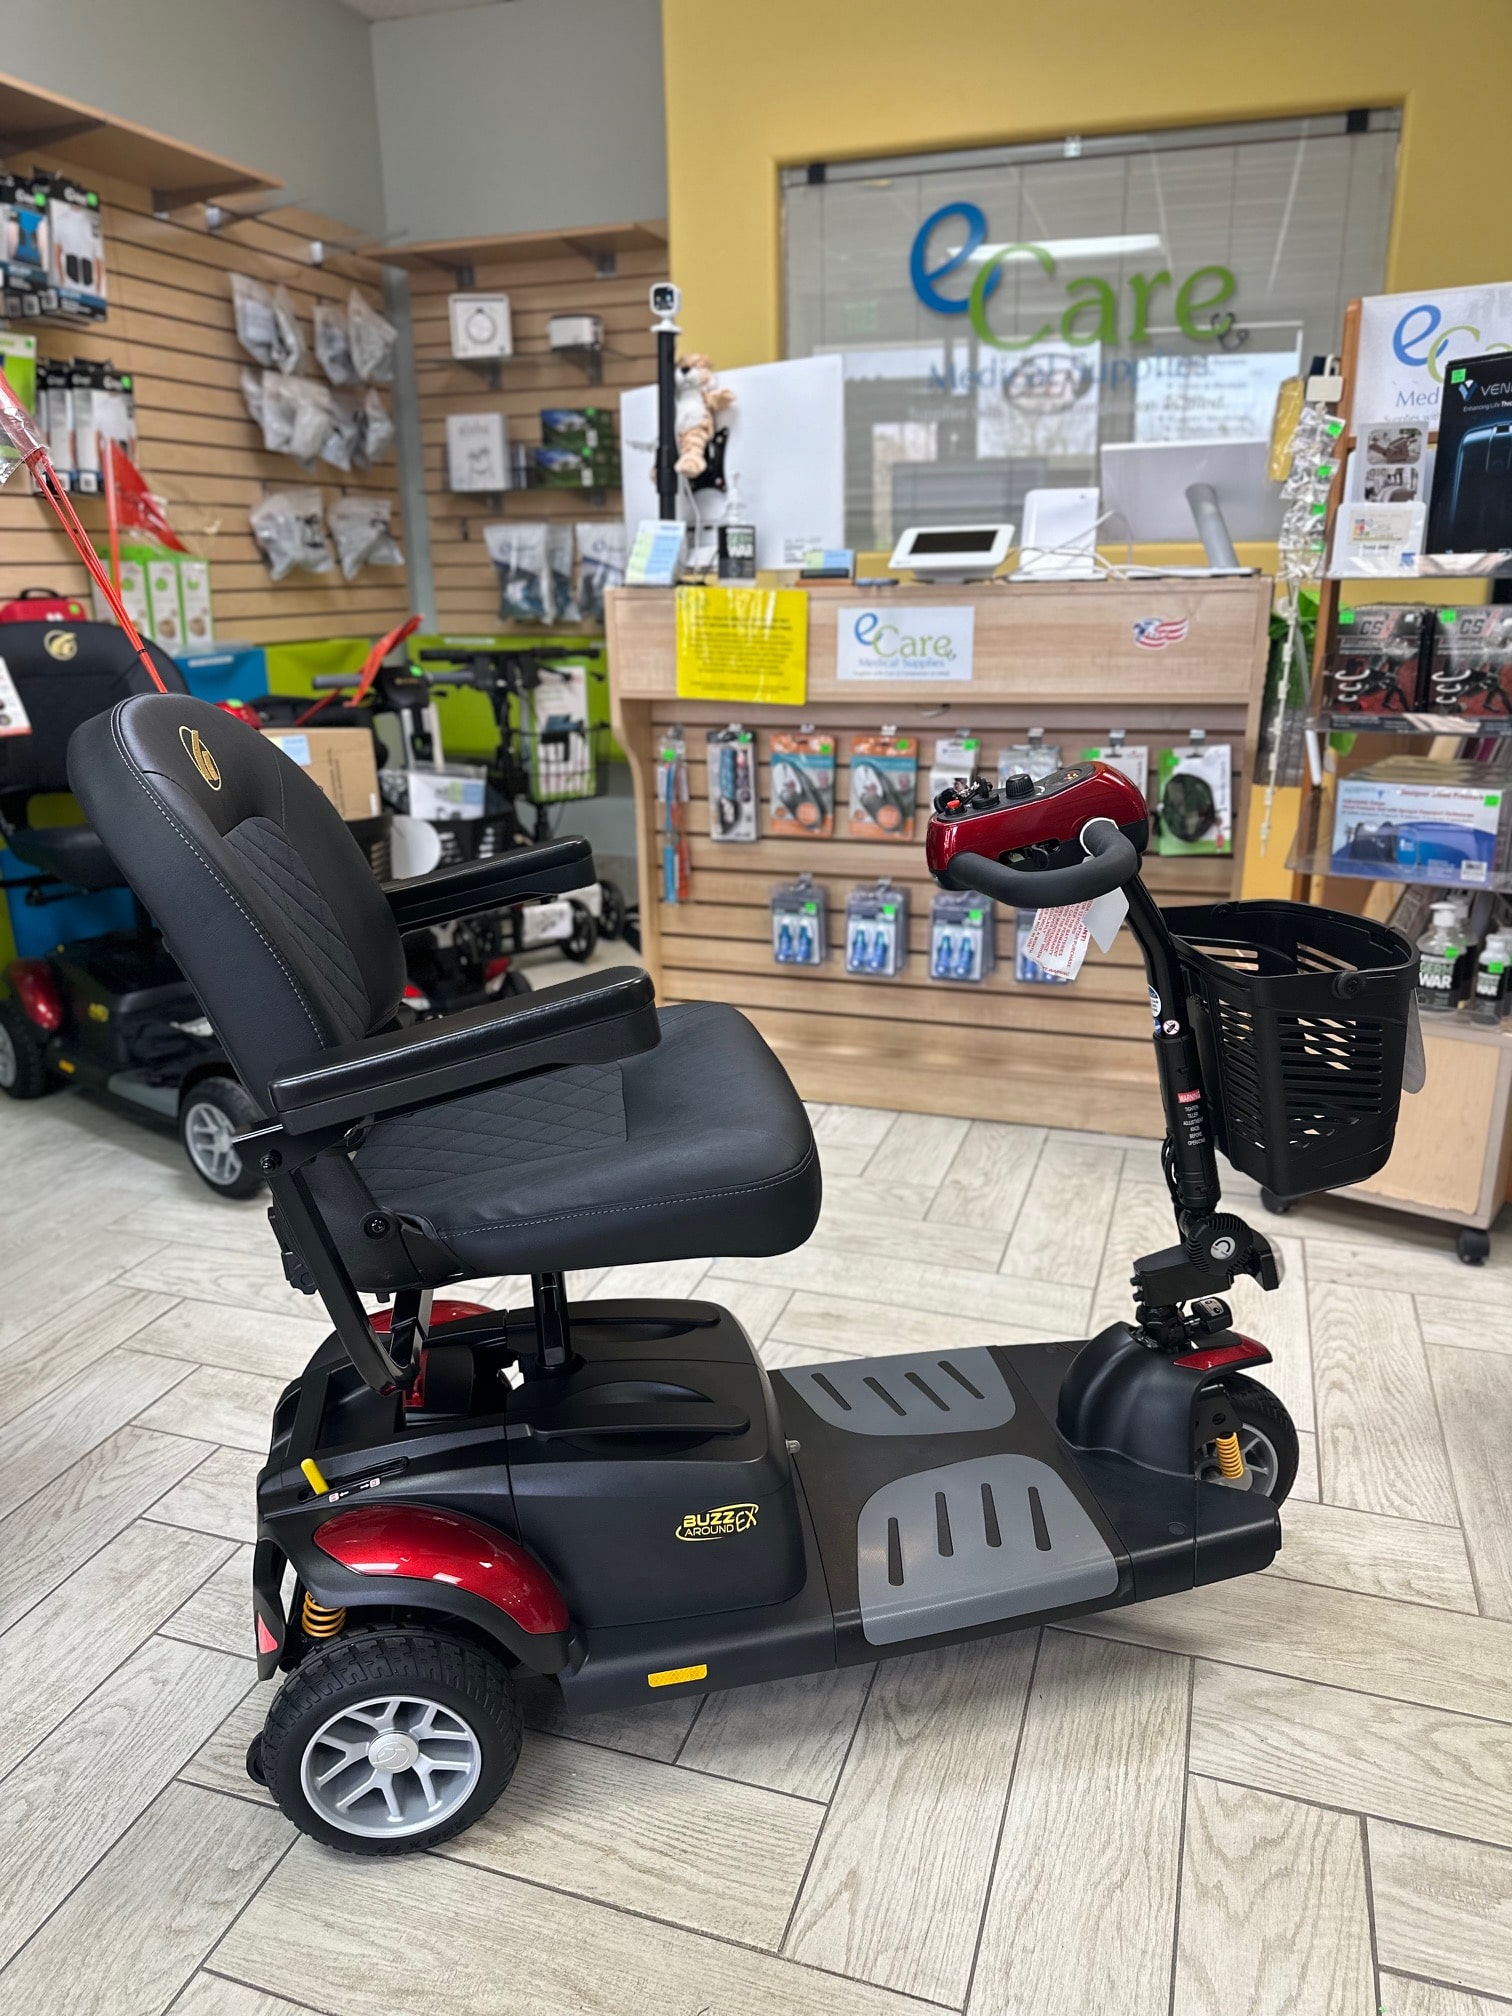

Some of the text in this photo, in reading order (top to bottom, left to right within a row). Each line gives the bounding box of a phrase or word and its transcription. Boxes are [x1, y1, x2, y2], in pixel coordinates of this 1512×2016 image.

[910, 201, 1237, 349] eCare
[1396, 386, 1440, 407] Med
[1481, 382, 1512, 396] VEN
[854, 612, 951, 658] eCare
[1419, 972, 1453, 989] WAR
[683, 1505, 757, 1533] BUZZ EX
[684, 1523, 735, 1537] AROUND
